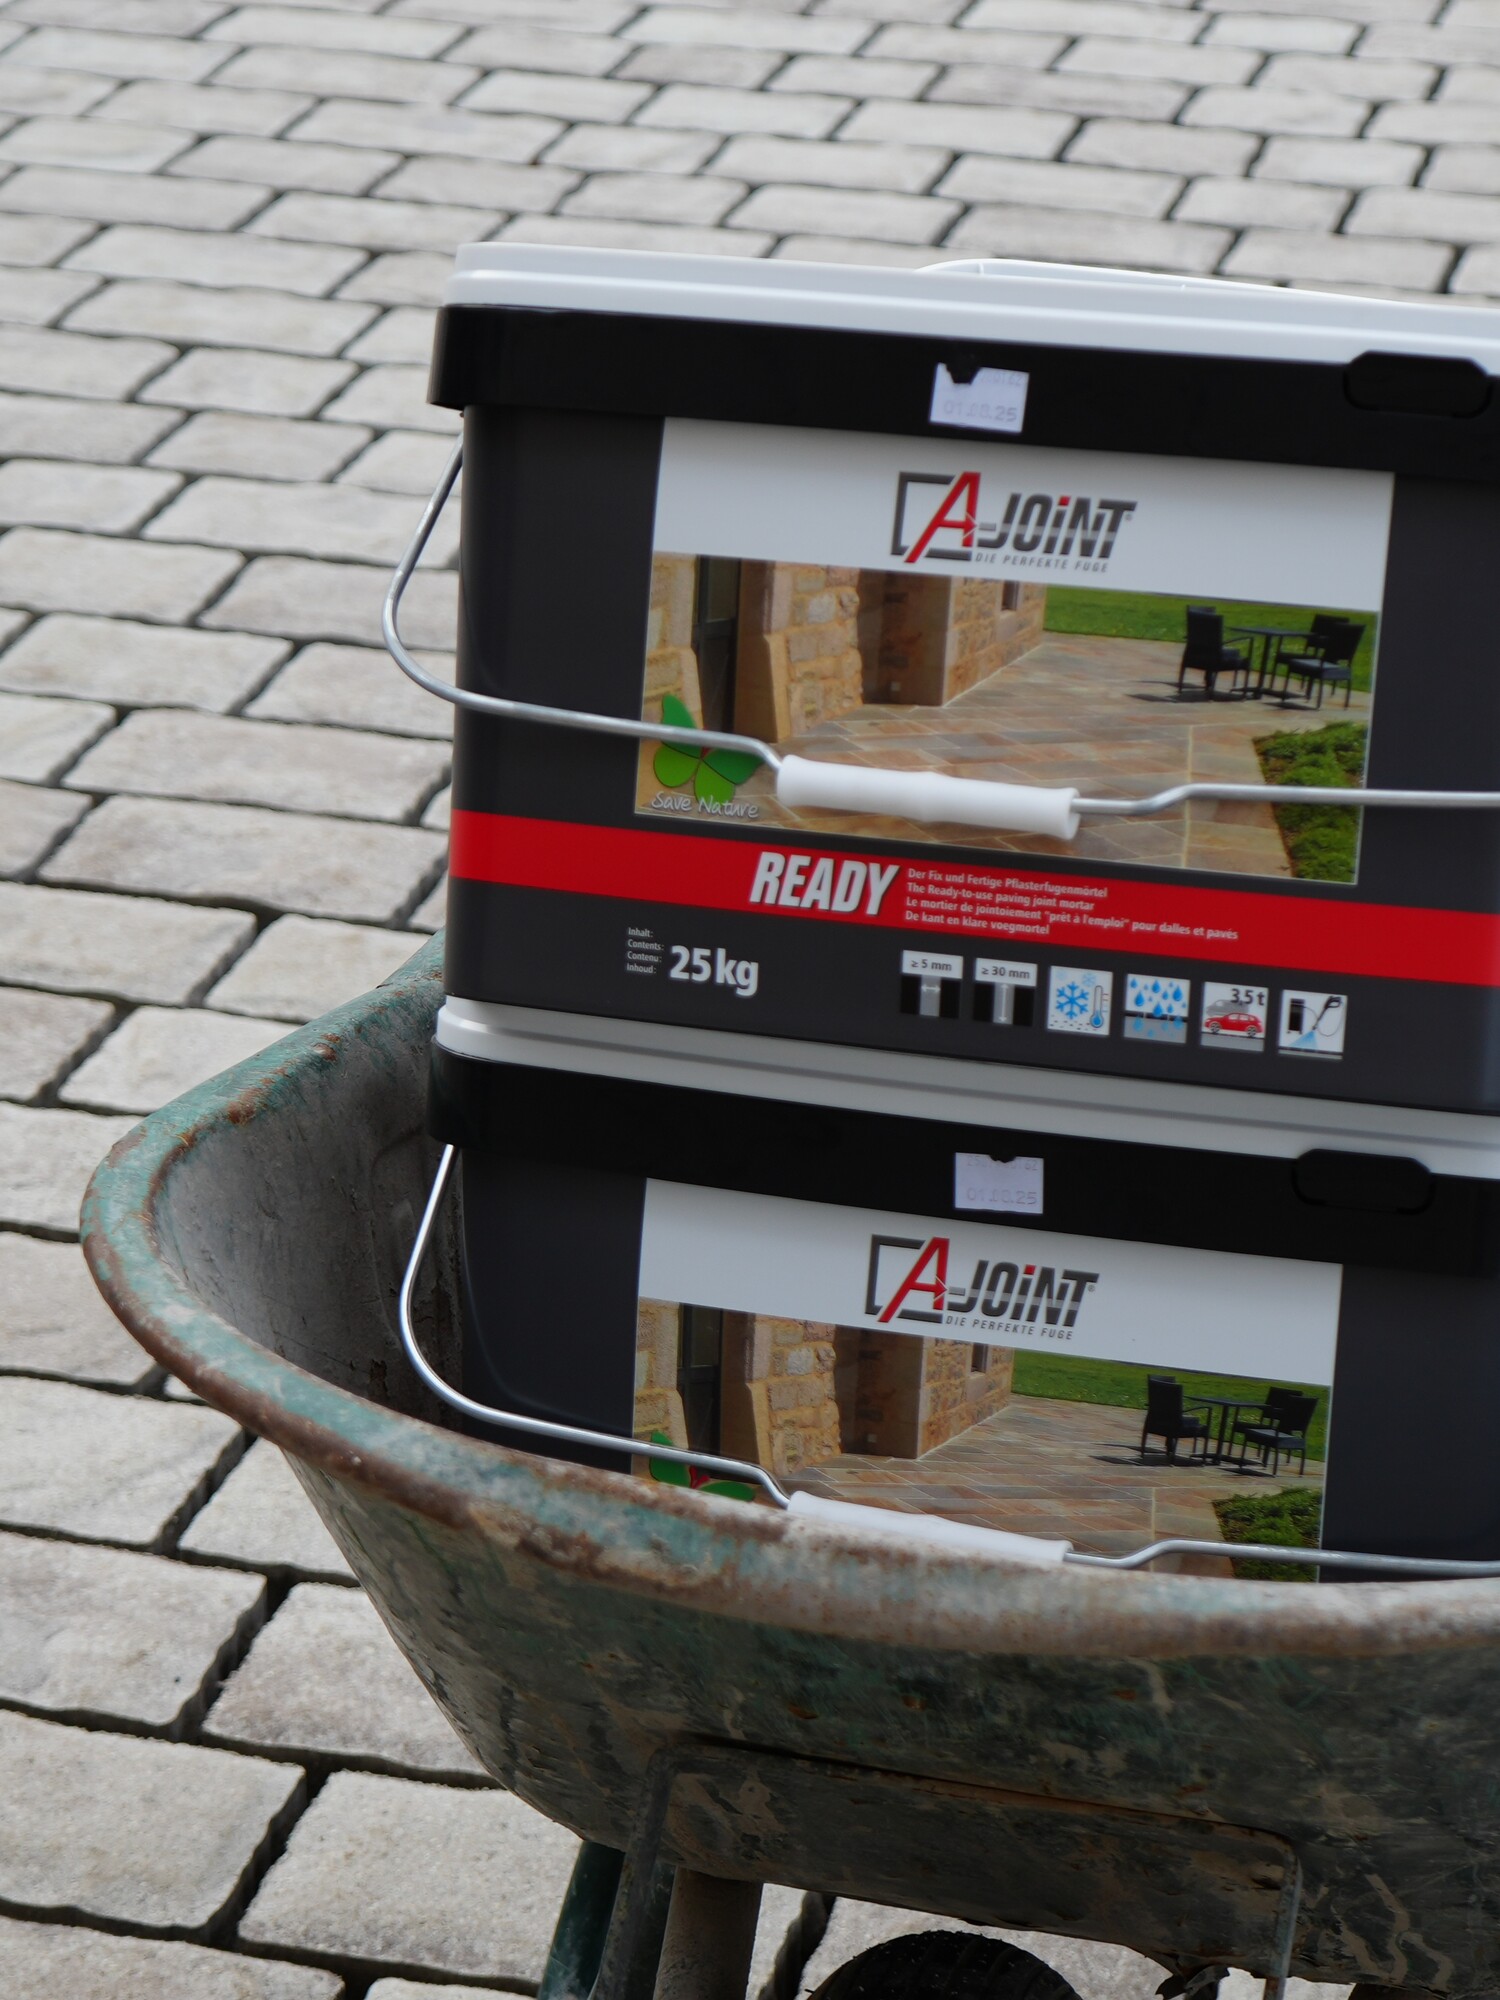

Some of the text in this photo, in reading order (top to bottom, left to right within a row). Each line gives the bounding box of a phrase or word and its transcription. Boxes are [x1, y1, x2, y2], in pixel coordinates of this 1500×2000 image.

[975, 551, 1109, 573] DIE PERFEKTE FUGE
[651, 790, 759, 818] Save Nature
[749, 851, 900, 916] READY
[908, 868, 1108, 898] Der Fix und Fertige Pflasterfugenmörtel
[907, 882, 1095, 911] The Ready-to-use paving joint mortar
[905, 910, 1050, 935] De kant en klare voegmortel
[906, 896, 919, 907] Le
[920, 898, 958, 911] mortier
[960, 901, 973, 912] de
[976, 903, 1042, 920] jointoiement
[1132, 920, 1156, 932] pour
[1159, 922, 1191, 935] dalles
[1193, 925, 1205, 936] et
[1206, 928, 1239, 940] pavés
[628, 927, 654, 938] Inhalt:
[627, 938, 664, 951] Contents:
[626, 962, 657, 974] Inhoud:
[627, 950, 662, 963] Contenu:
[921, 959, 928, 969] 5
[931, 961, 952, 971] mm
[991, 966, 1006, 977] 30
[1008, 969, 1030, 979] mm
[946, 1315, 1074, 1340] DIE PERFEKTE FUGE
